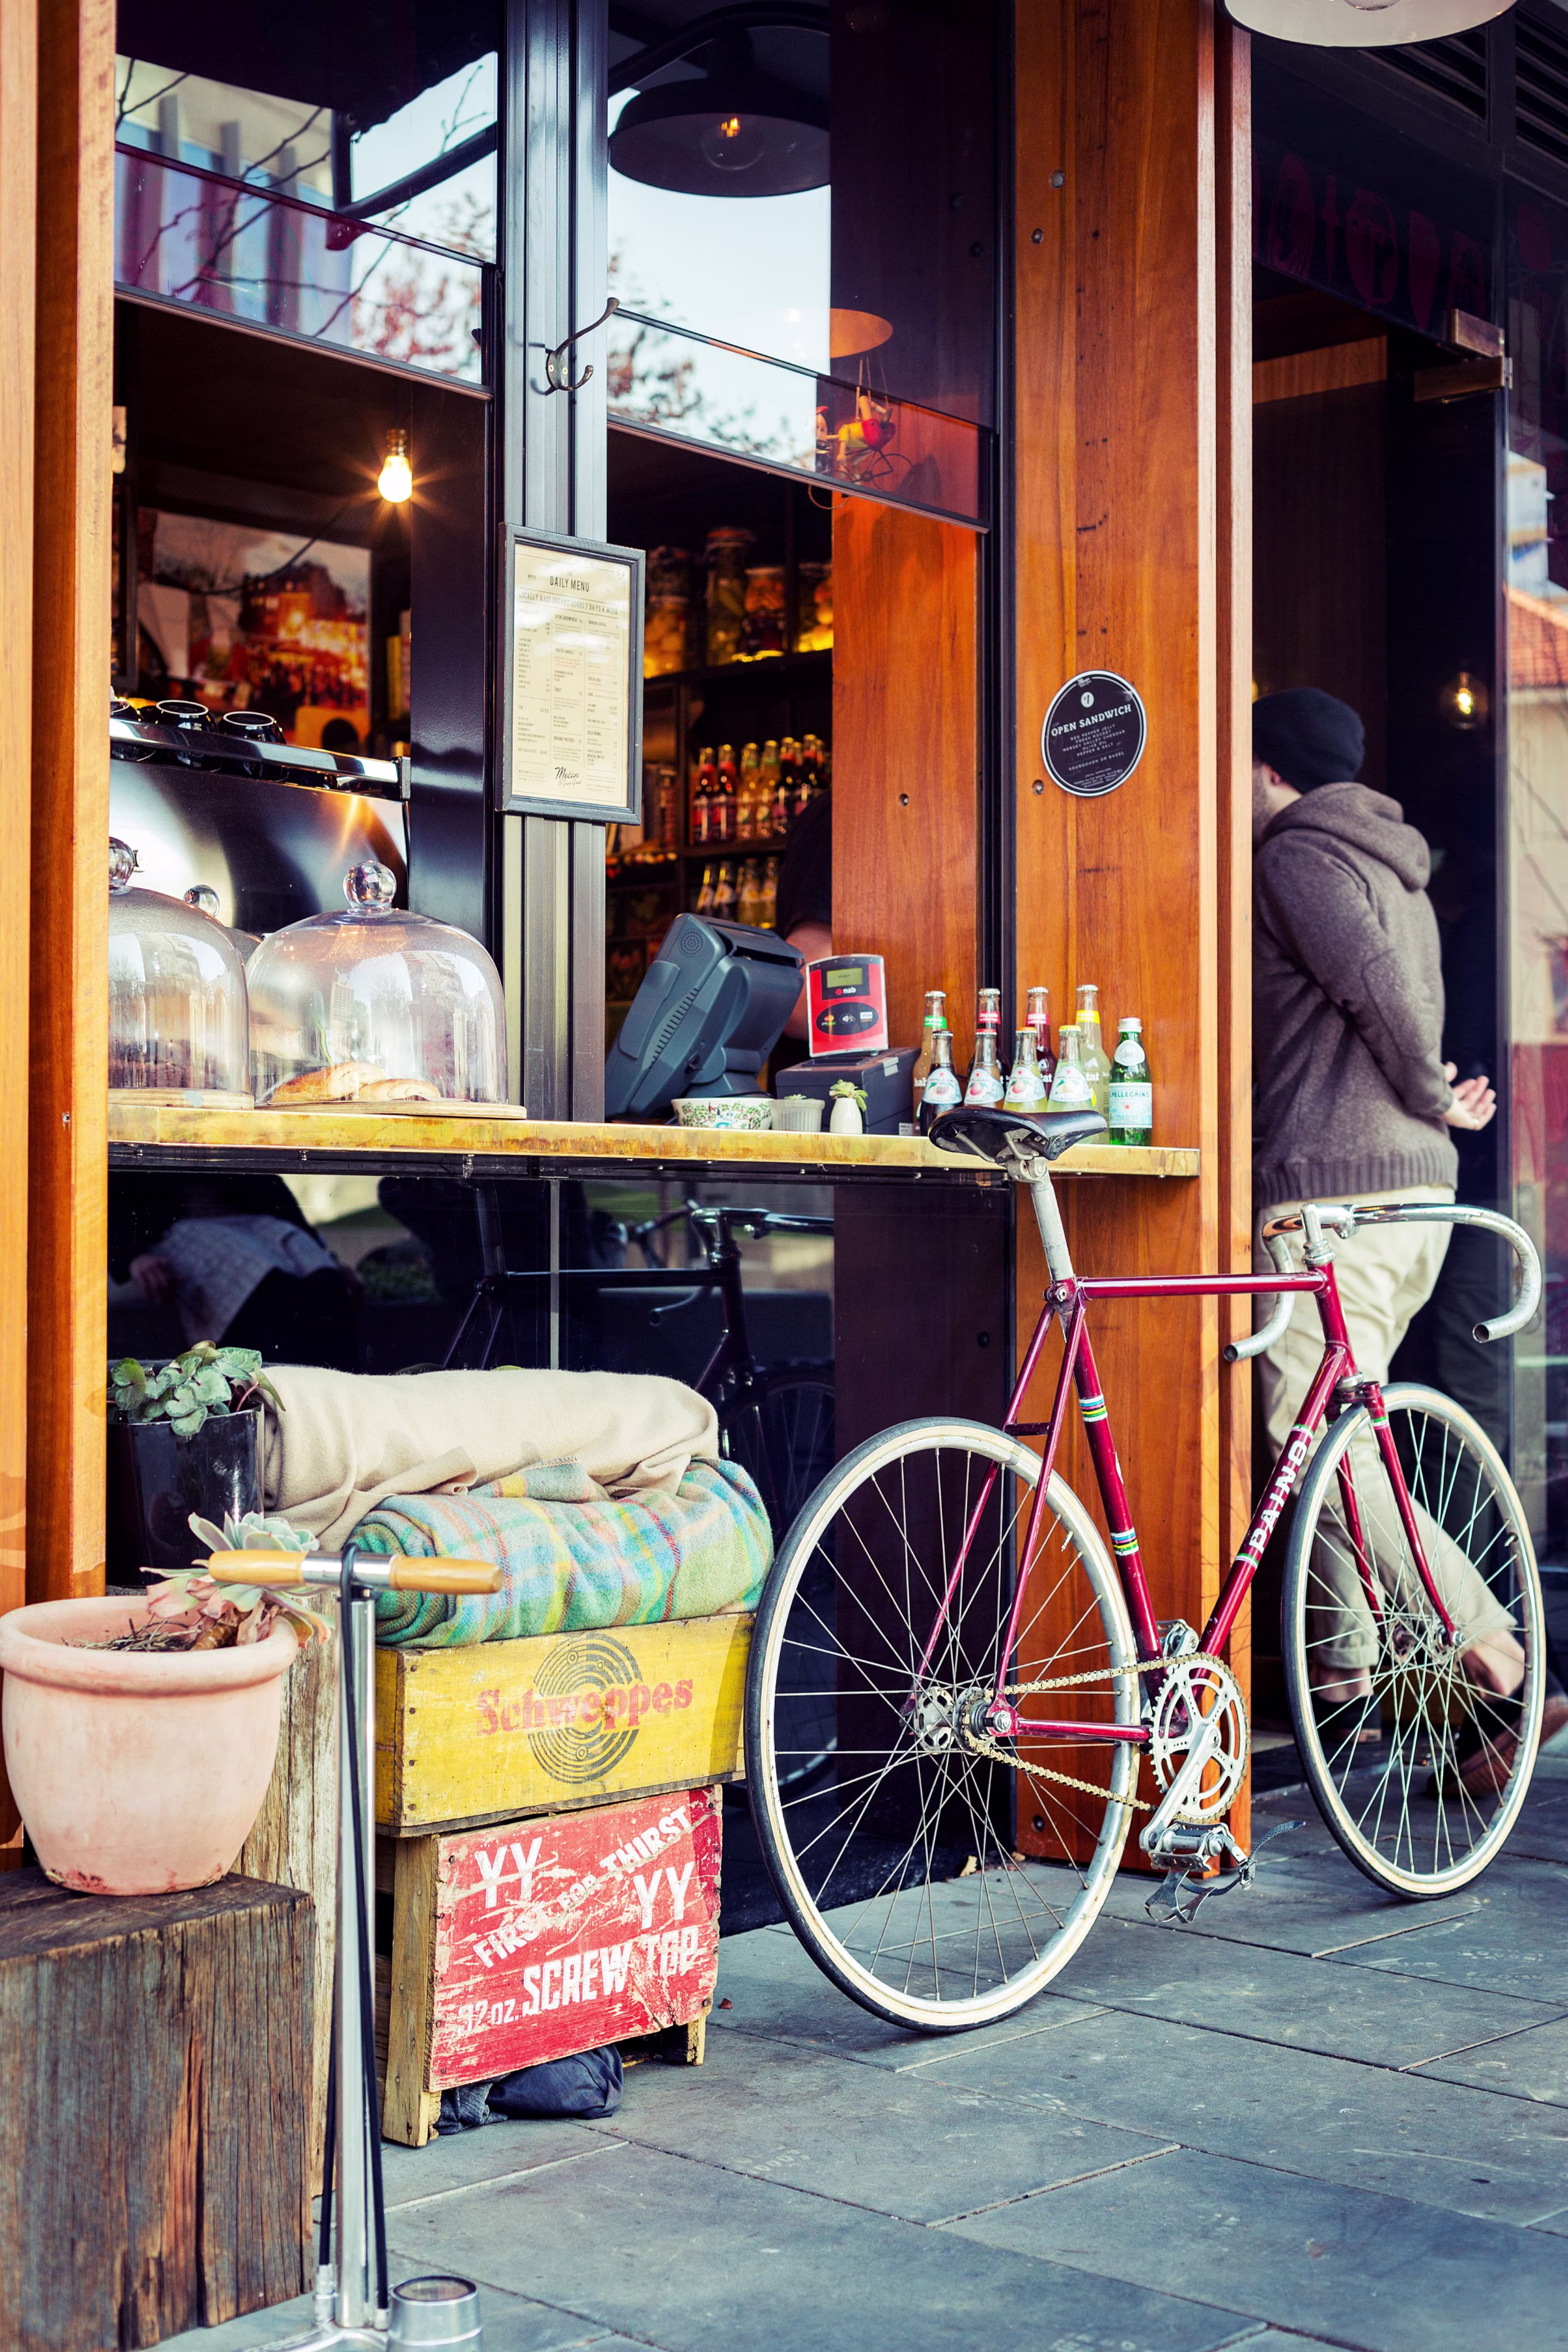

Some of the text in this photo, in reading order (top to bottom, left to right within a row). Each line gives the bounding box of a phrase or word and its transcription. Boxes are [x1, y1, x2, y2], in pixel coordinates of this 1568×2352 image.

[519, 591, 538, 600] LOCALLY
[589, 604, 601, 612] DAYS
[550, 575, 589, 592] DAILY MENU
[1051, 704, 1131, 736] OPEN SANDWICH
[1093, 730, 1111, 738] ROCKET
[1103, 730, 1125, 739] CHEDDAR
[1069, 760, 1098, 771] SOURDOUGH
[1249, 1440, 1307, 1554] PAINO
[476, 1679, 693, 1736] Schweppes
[474, 1837, 542, 1908] YY
[556, 1873, 603, 1911] FOR
[599, 1806, 693, 1883] THIRST
[633, 1862, 695, 1930] YY
[522, 1941, 633, 2017] SCREW
[641, 1926, 699, 1977] TOP
